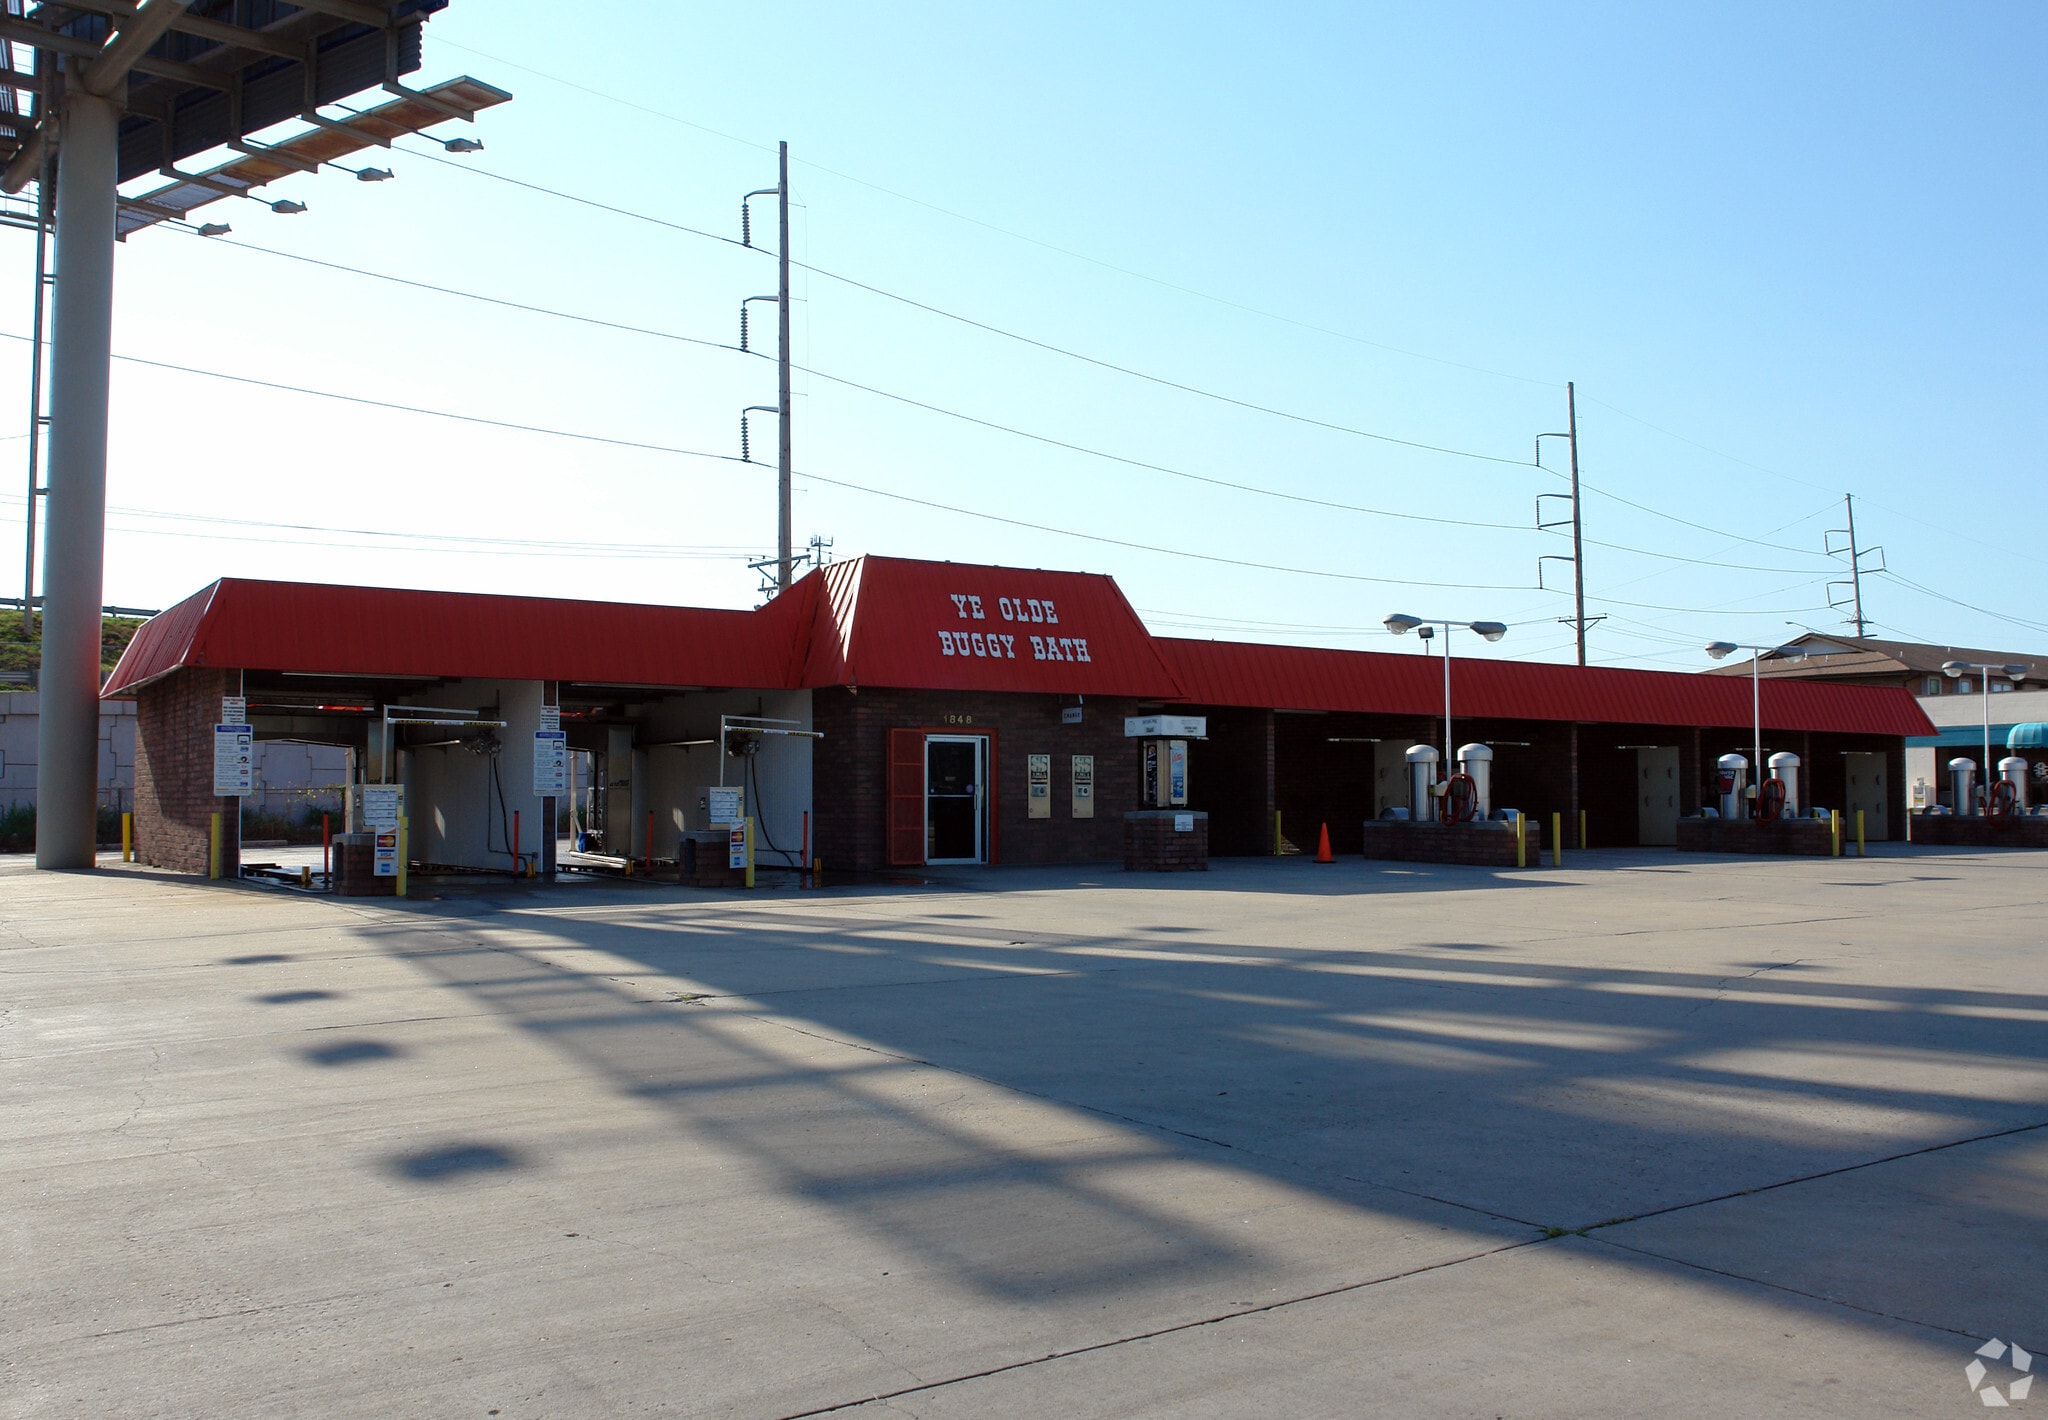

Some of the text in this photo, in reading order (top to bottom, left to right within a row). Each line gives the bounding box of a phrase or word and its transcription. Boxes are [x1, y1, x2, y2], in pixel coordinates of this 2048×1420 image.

[950, 593, 1059, 624] YE OLDE
[937, 630, 1092, 663] BUGGY BATH
[943, 714, 972, 725] 1848
